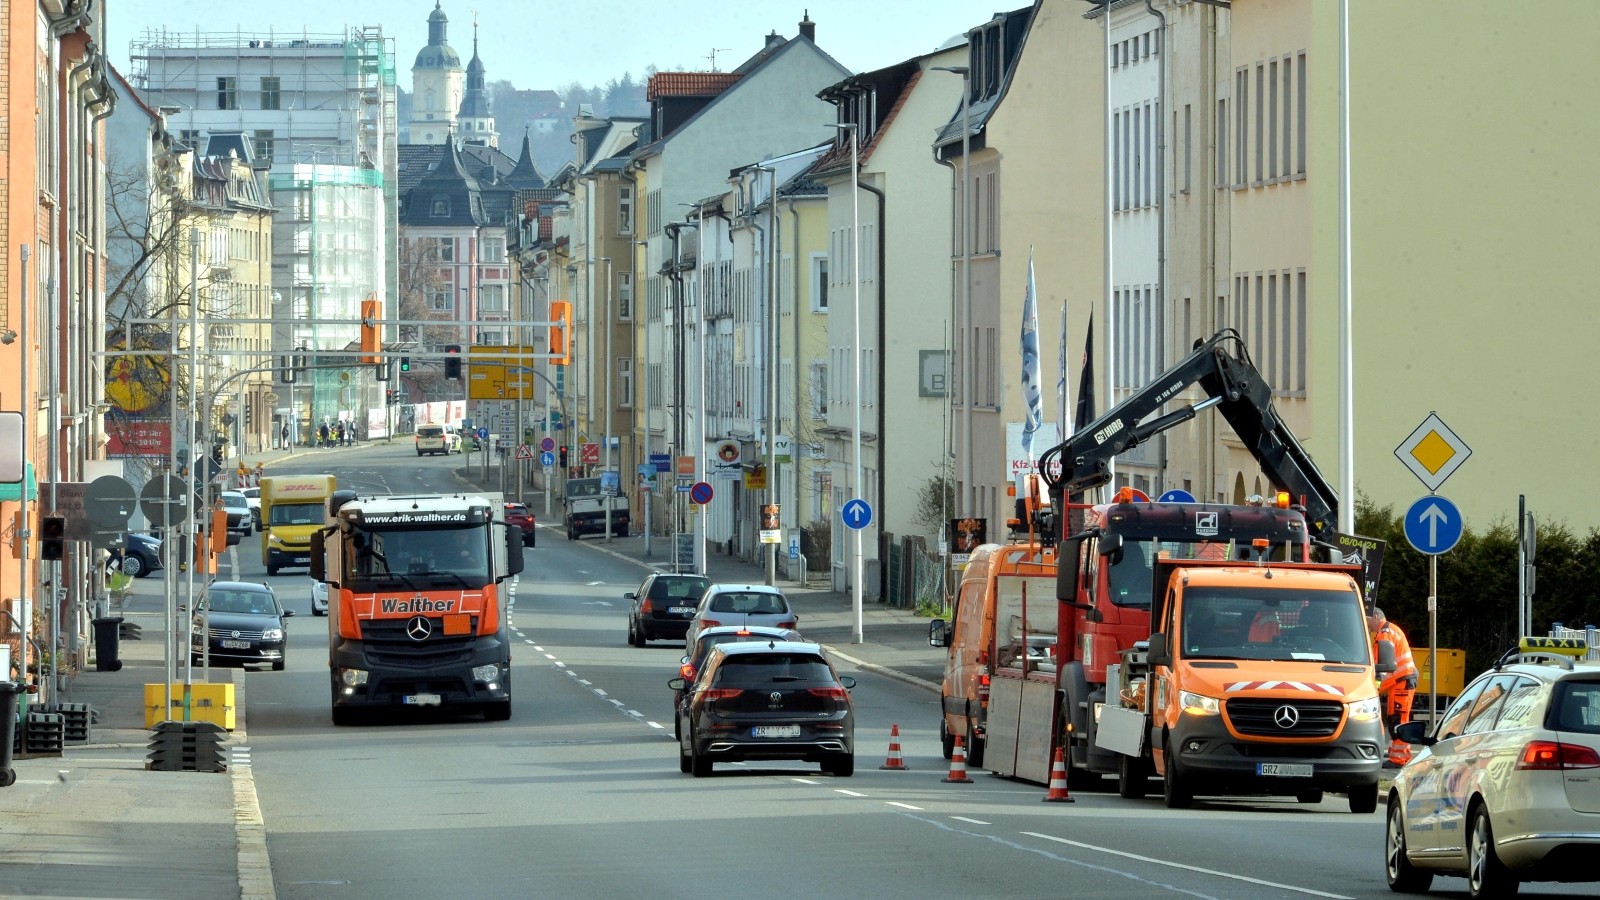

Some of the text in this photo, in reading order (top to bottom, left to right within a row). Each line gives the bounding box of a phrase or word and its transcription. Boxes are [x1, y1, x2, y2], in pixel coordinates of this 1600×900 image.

[364, 513, 467, 523] www.erik-walther.de
[381, 597, 455, 613] Walther
[1532, 638, 1578, 648] TAXI
